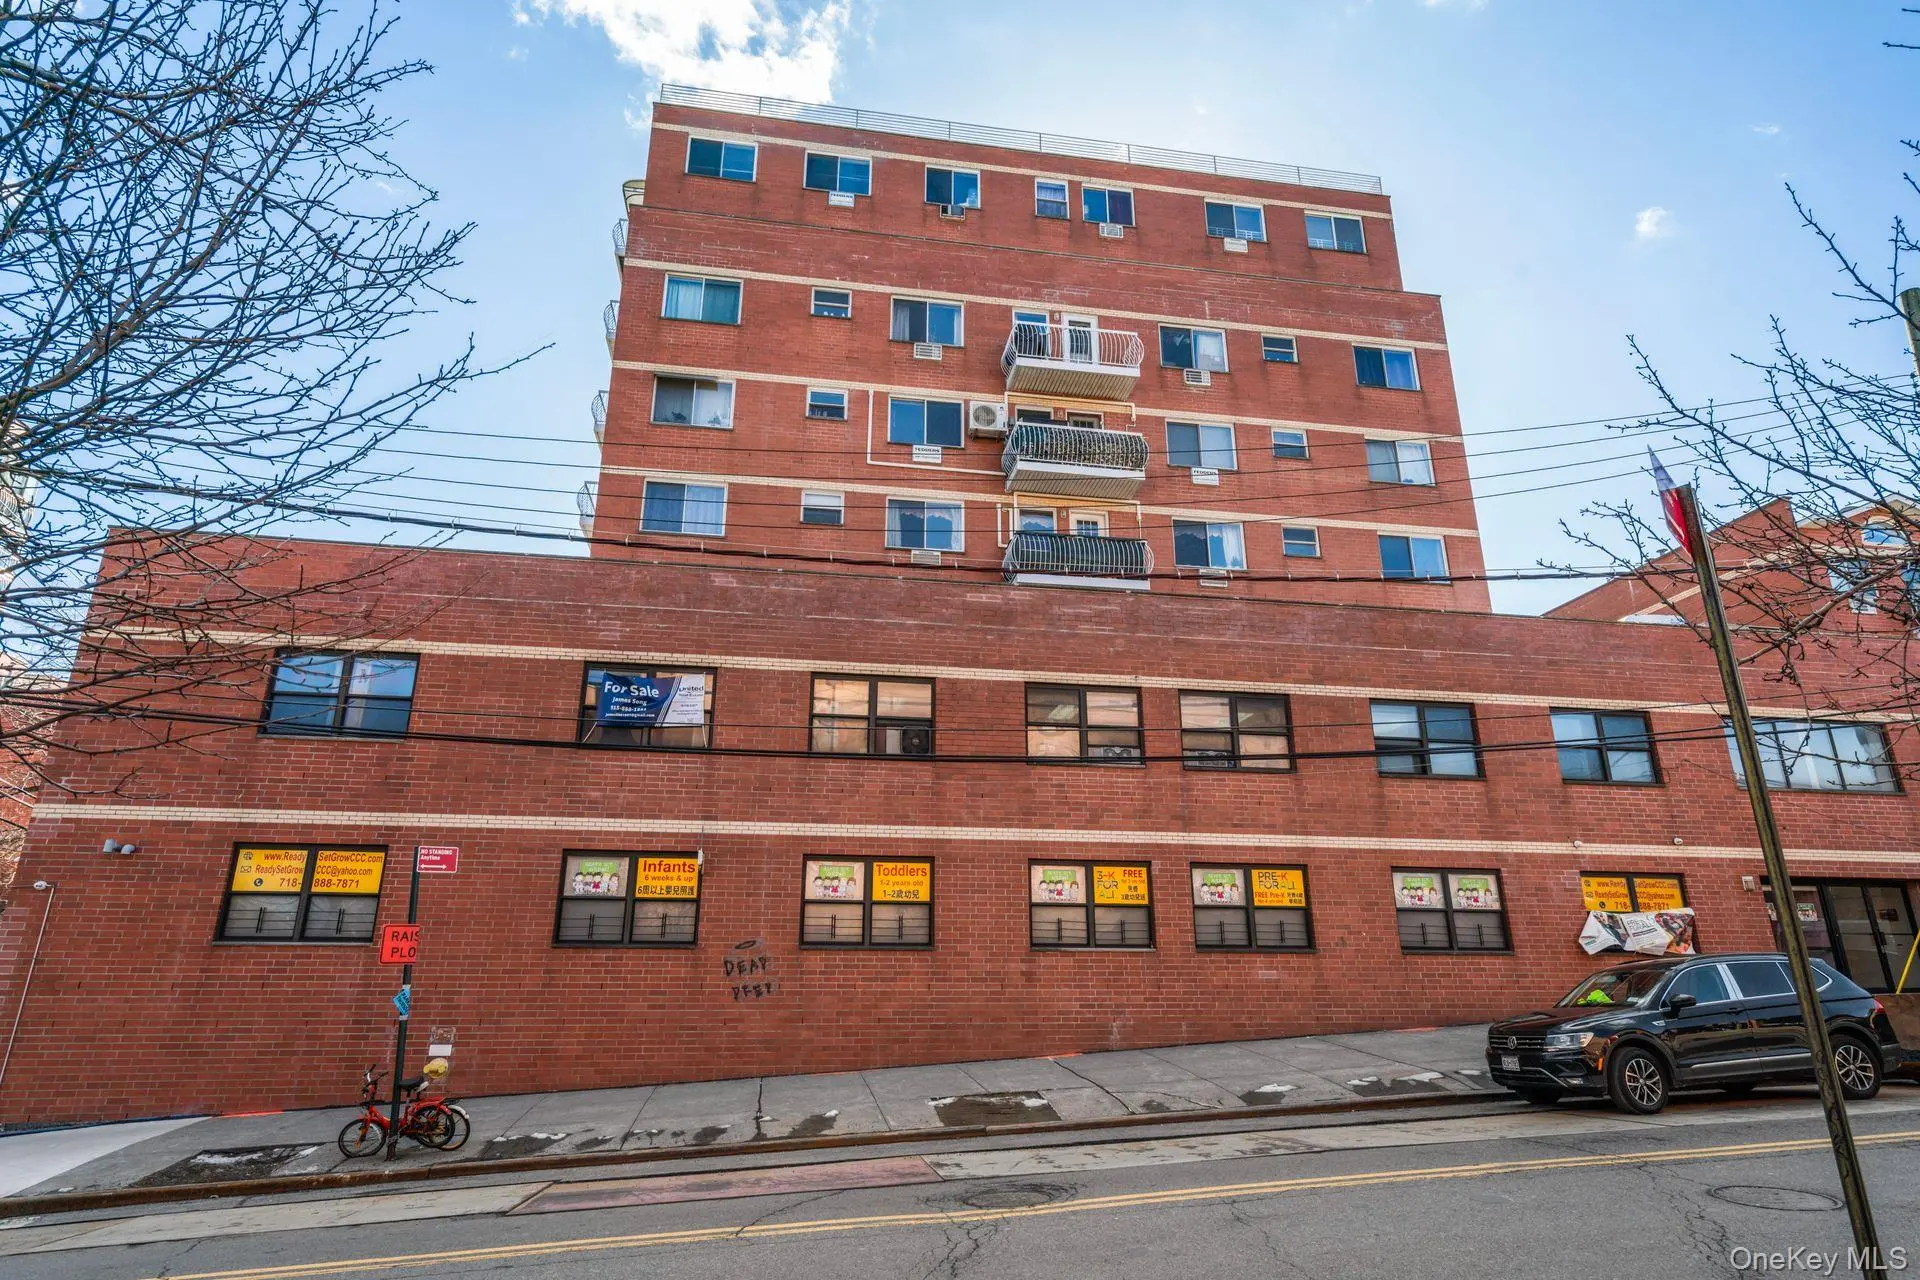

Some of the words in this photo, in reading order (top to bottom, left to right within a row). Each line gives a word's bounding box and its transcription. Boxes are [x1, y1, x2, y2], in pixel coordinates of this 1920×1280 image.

[604, 681, 628, 694] For
[629, 685, 660, 698] Sale
[612, 696, 632, 704] James
[264, 851, 307, 864] www.Ready
[319, 852, 384, 863] SetGrowCCC.com
[255, 865, 304, 876] ReadySetGrow
[316, 865, 373, 877] CCC@yahoo.com
[643, 860, 696, 873] Infants
[876, 864, 928, 877] Toddlers
[1123, 869, 1143, 878] FREE
[1257, 871, 1288, 881] PRE-K
[1097, 880, 1119, 890] FOR
[1258, 880, 1279, 890] FOR
